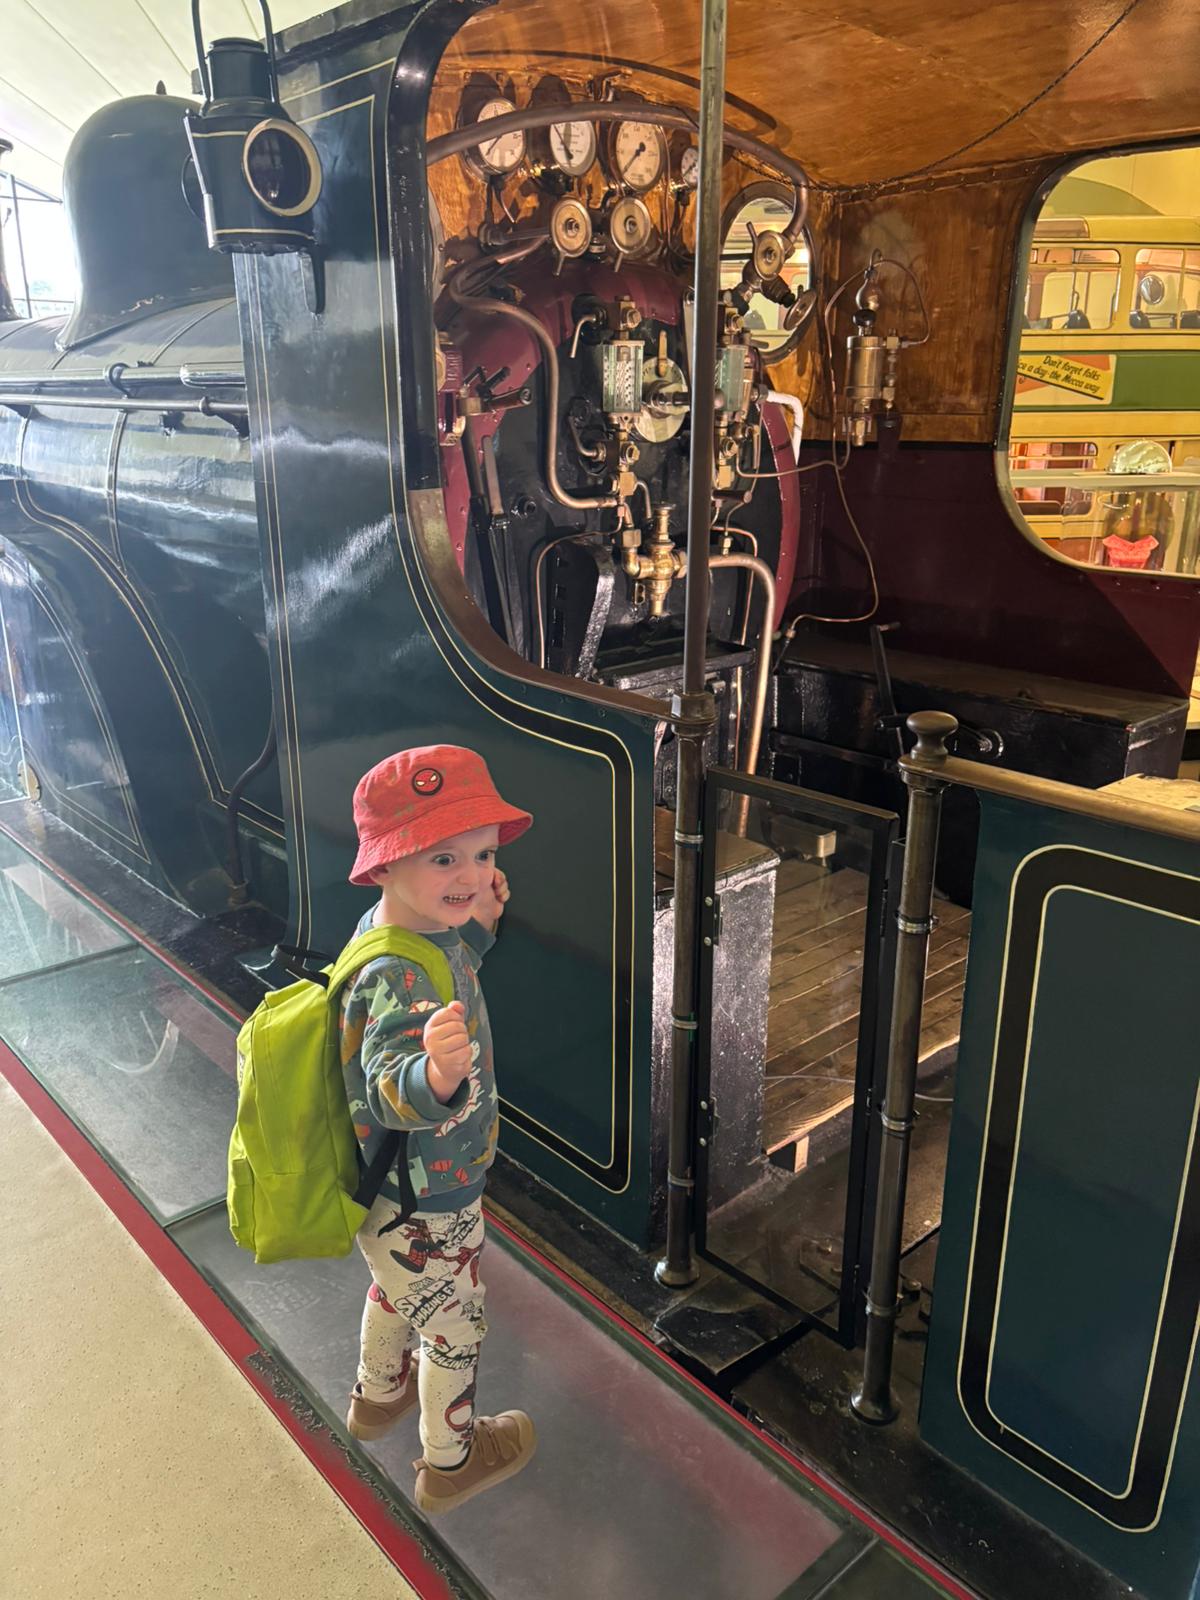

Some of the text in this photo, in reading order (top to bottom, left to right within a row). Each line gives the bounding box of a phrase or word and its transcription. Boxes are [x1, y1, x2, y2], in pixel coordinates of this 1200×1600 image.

[1027, 365, 1034, 373] a
[1034, 366, 1048, 378] day
[1049, 370, 1062, 381] the
[1061, 374, 1085, 388] Mecca
[1084, 383, 1101, 394] way
[1043, 355, 1101, 381] Don't forget folks
[410, 1292, 449, 1329] AMAZING
[422, 1346, 470, 1370] AMAZING
